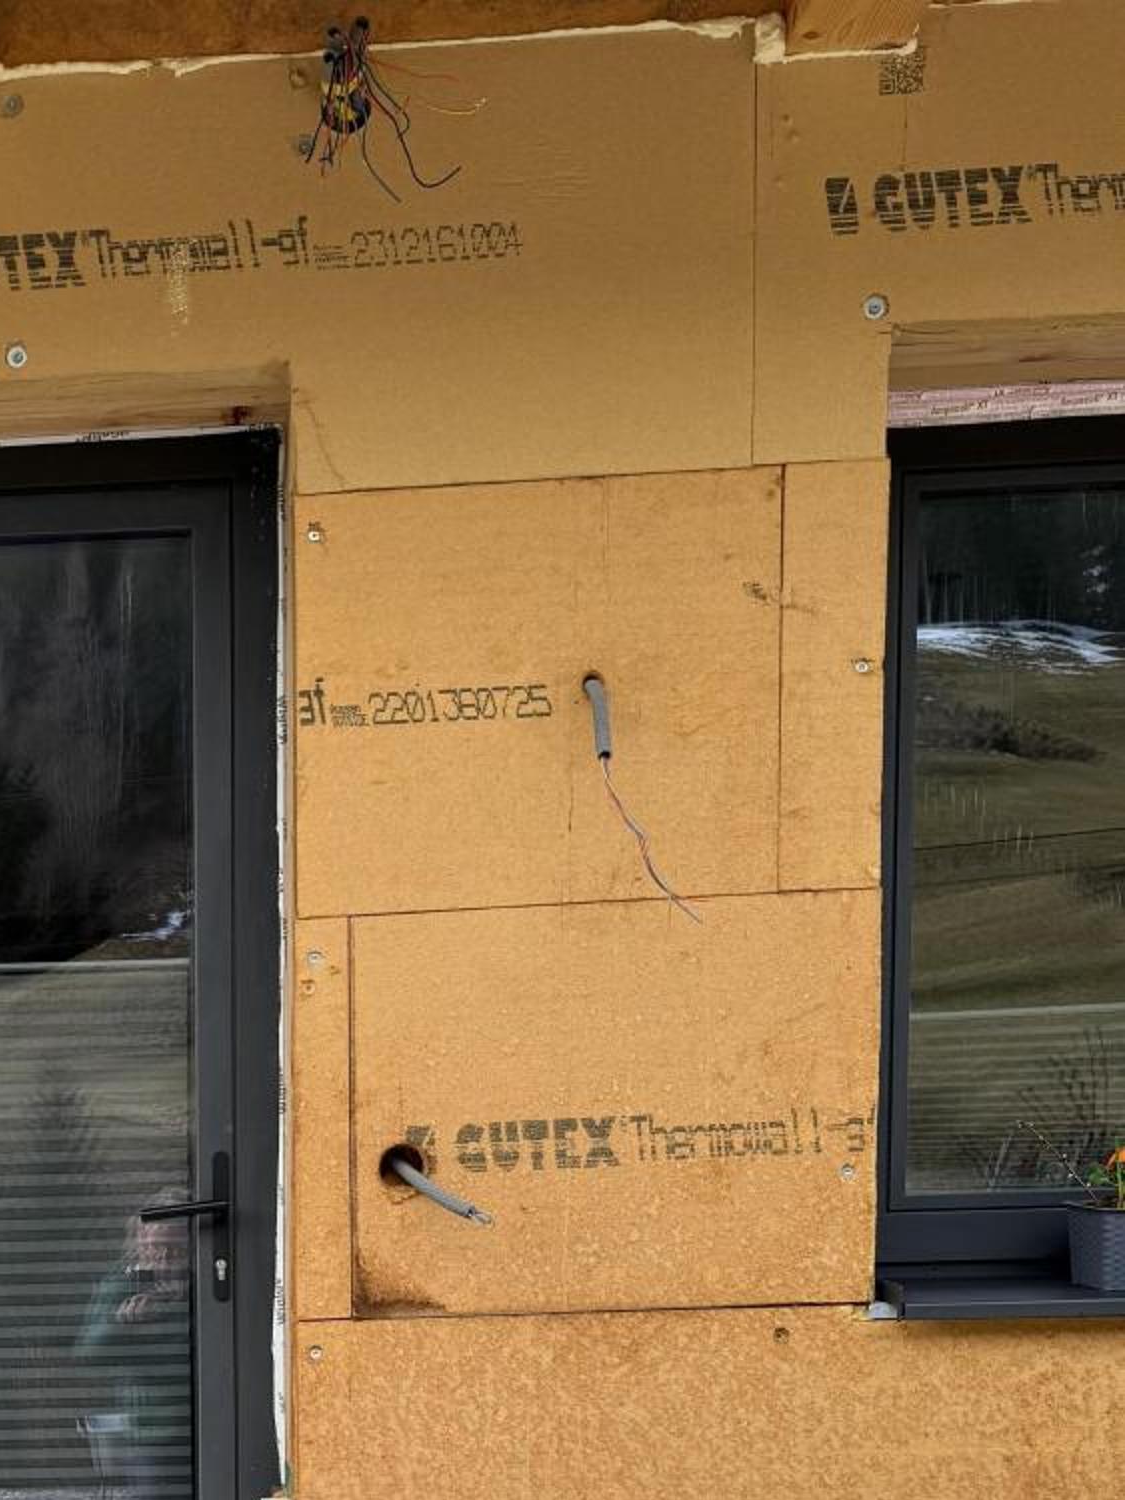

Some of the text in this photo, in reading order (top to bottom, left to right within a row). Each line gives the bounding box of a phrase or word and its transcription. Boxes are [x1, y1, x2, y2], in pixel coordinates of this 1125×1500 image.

[873, 165, 1033, 232] GUTEX
[367, 684, 553, 725] 2201380725
[455, 1115, 620, 1172] GUTEX
